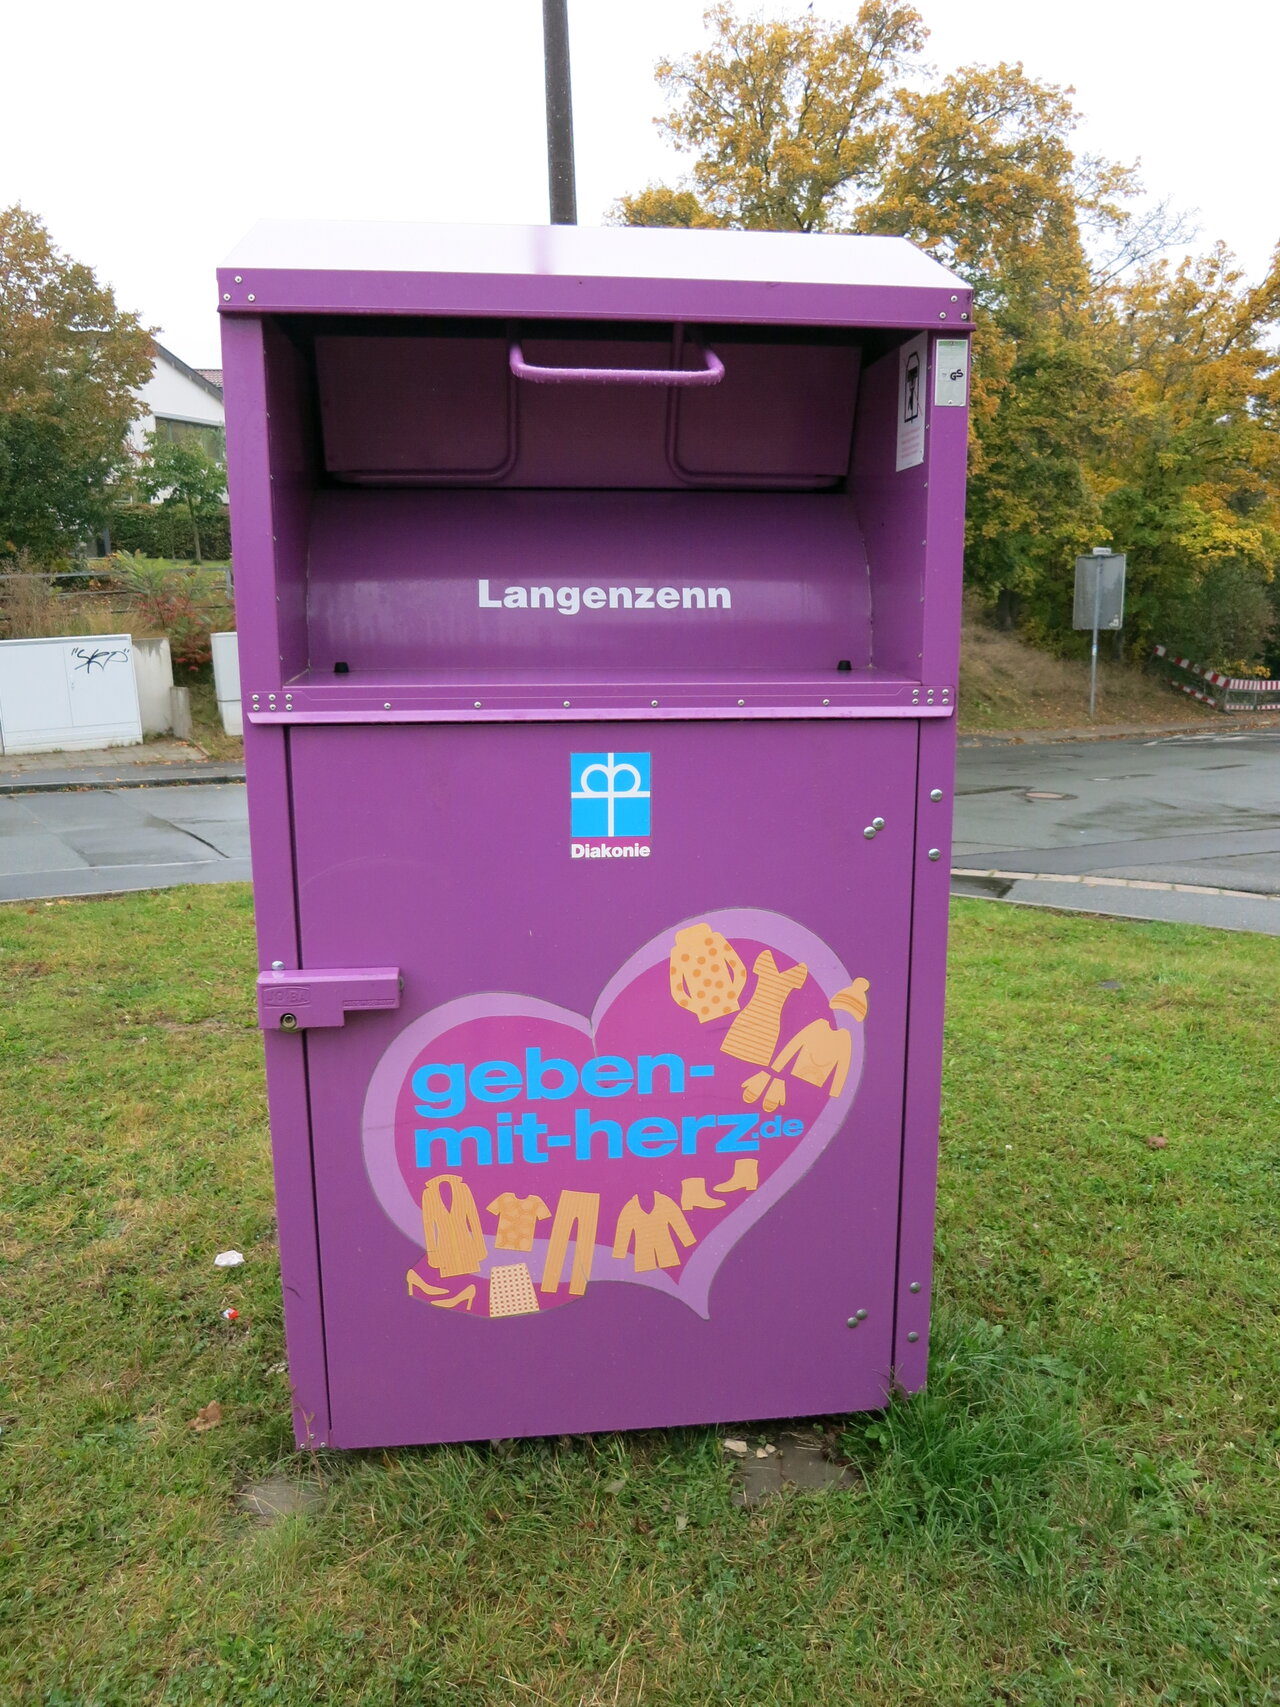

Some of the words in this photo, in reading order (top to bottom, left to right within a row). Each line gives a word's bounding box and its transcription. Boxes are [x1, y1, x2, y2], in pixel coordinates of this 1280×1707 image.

[478, 579, 732, 615] Langenzenn
[571, 843, 651, 859] Diakonie
[412, 1047, 715, 1118] geben-
